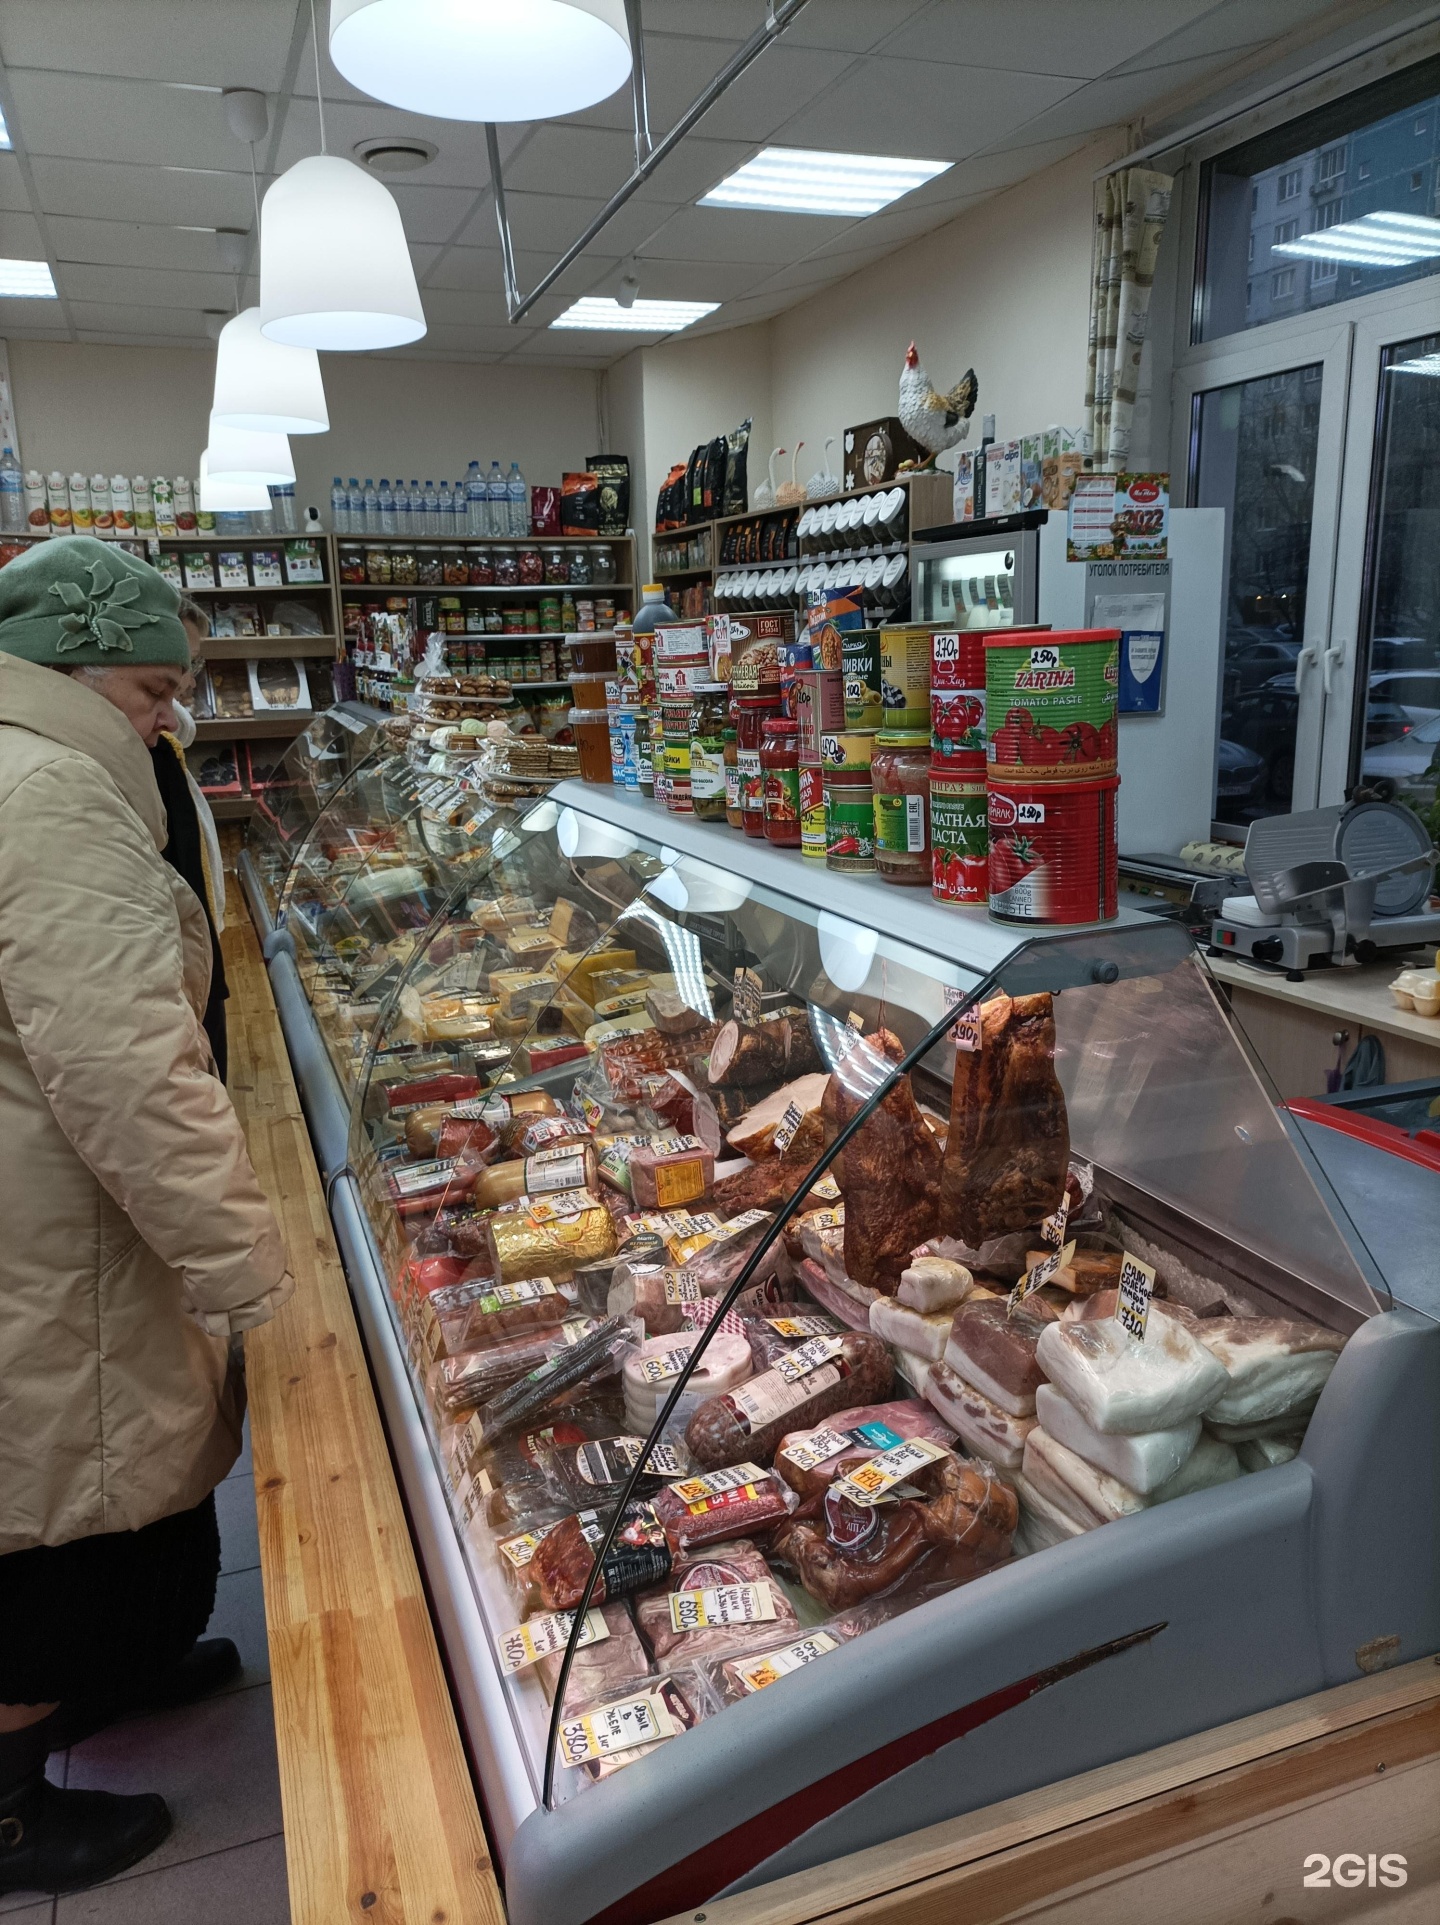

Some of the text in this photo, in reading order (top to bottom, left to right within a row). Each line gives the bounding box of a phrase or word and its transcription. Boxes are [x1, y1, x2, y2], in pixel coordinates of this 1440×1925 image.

[1089, 563, 1170, 577] УГОЛОК ПОТРЕБИТЕЛЯ
[760, 619, 779, 628] ГОСТ
[1014, 667, 1075, 690] ZARINA
[1010, 695, 1083, 707] TOMATO PASTE
[504, 1633, 526, 1668] 780р
[562, 1722, 588, 1762] 380р
